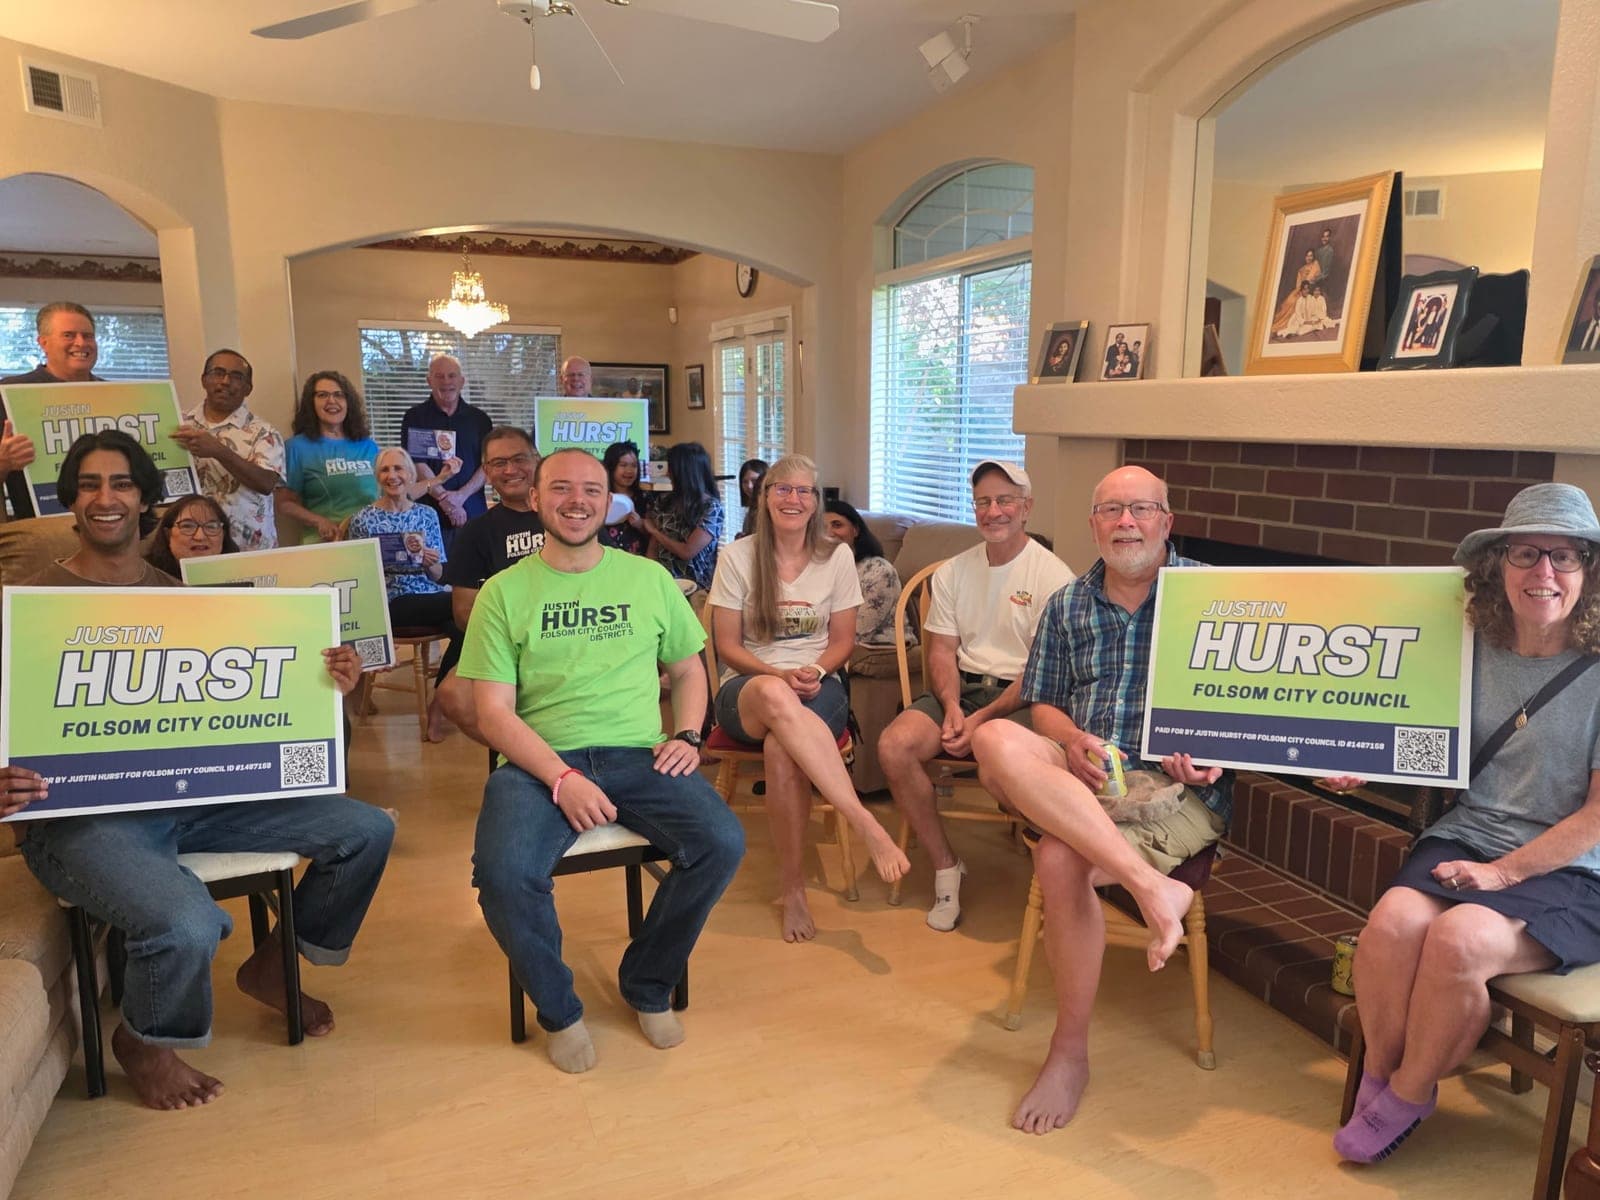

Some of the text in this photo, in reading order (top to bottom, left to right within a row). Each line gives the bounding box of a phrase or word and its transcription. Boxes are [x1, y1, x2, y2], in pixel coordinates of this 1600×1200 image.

[44, 403, 92, 418] JUSTIN
[552, 420, 632, 443] HURST
[325, 459, 372, 476] HURST
[505, 533, 545, 553] HUR
[506, 530, 531, 541] JUSTIN
[543, 600, 580, 611] JUSTIN
[1201, 600, 1288, 618] JUSTIN
[541, 604, 631, 632] HURST
[65, 625, 164, 645] JUSTIN
[540, 622, 632, 640] FOLSOM CITY COUNCIL
[590, 630, 626, 642] DISTRICT
[1188, 620, 1421, 680] HURST
[54, 646, 297, 708] HURST
[1192, 683, 1411, 709] FOLSOM CITY COUNCIL
[61, 712, 293, 738] FOLSOM CITY COUNCIL
[1194, 729, 1219, 737] JUSTIN
[1219, 731, 1242, 739] HURST
[1242, 732, 1257, 740] FOR
[1257, 734, 1287, 743] FOLSOM
[1287, 736, 1304, 744] CITY
[1304, 738, 1336, 747] COUNCIL
[67, 774, 97, 783] JUSTIN
[98, 772, 125, 781] HURST
[125, 770, 141, 778] FOR
[142, 769, 175, 777] FOLSOM
[175, 767, 193, 775] CITY
[193, 766, 226, 774] COUNCIL
[226, 764, 235, 772] ID
